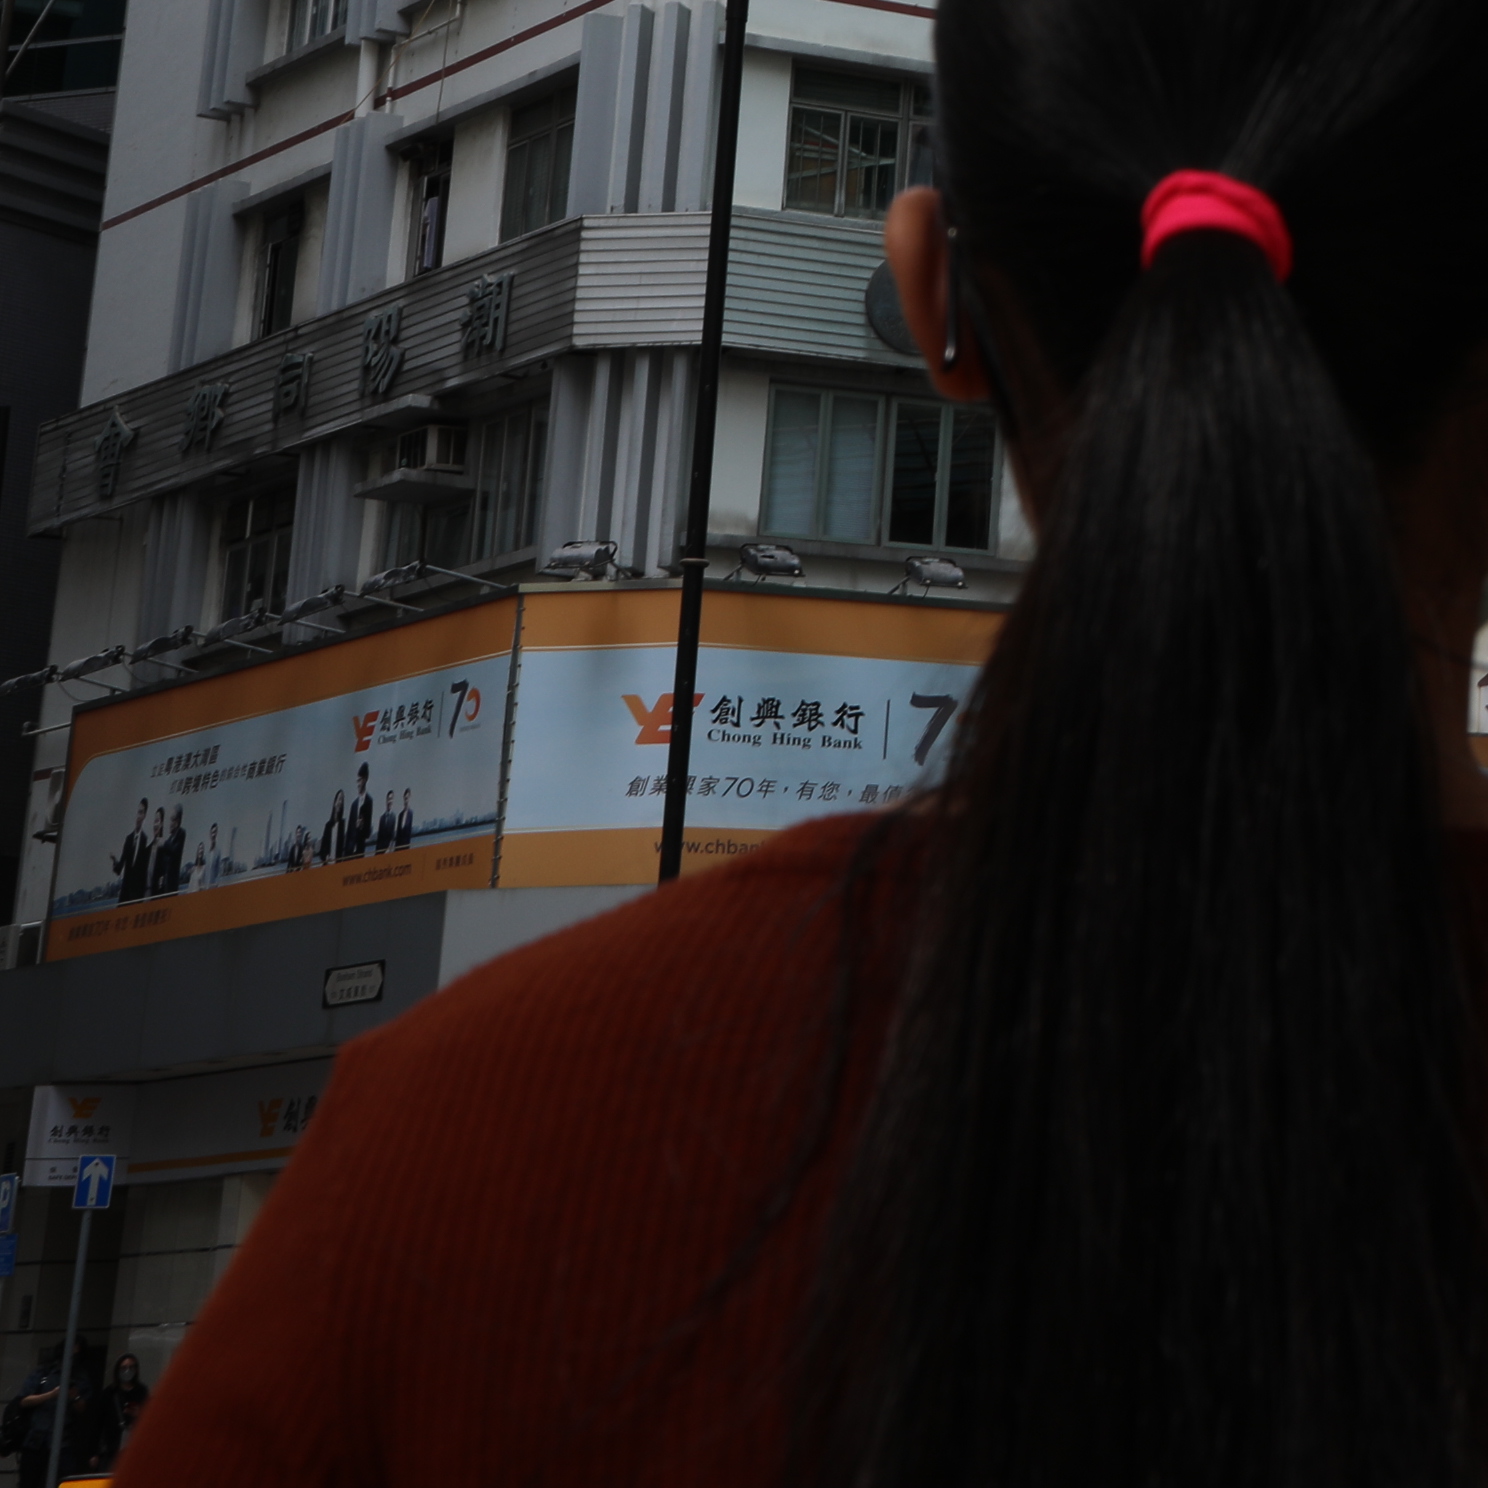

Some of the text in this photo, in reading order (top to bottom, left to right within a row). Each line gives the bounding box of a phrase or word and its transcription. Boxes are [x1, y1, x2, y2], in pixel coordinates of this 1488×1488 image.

[709, 693, 866, 735] 創興銀行
[908, 691, 960, 767] 7
[706, 728, 864, 751] Chong Hing Bank
